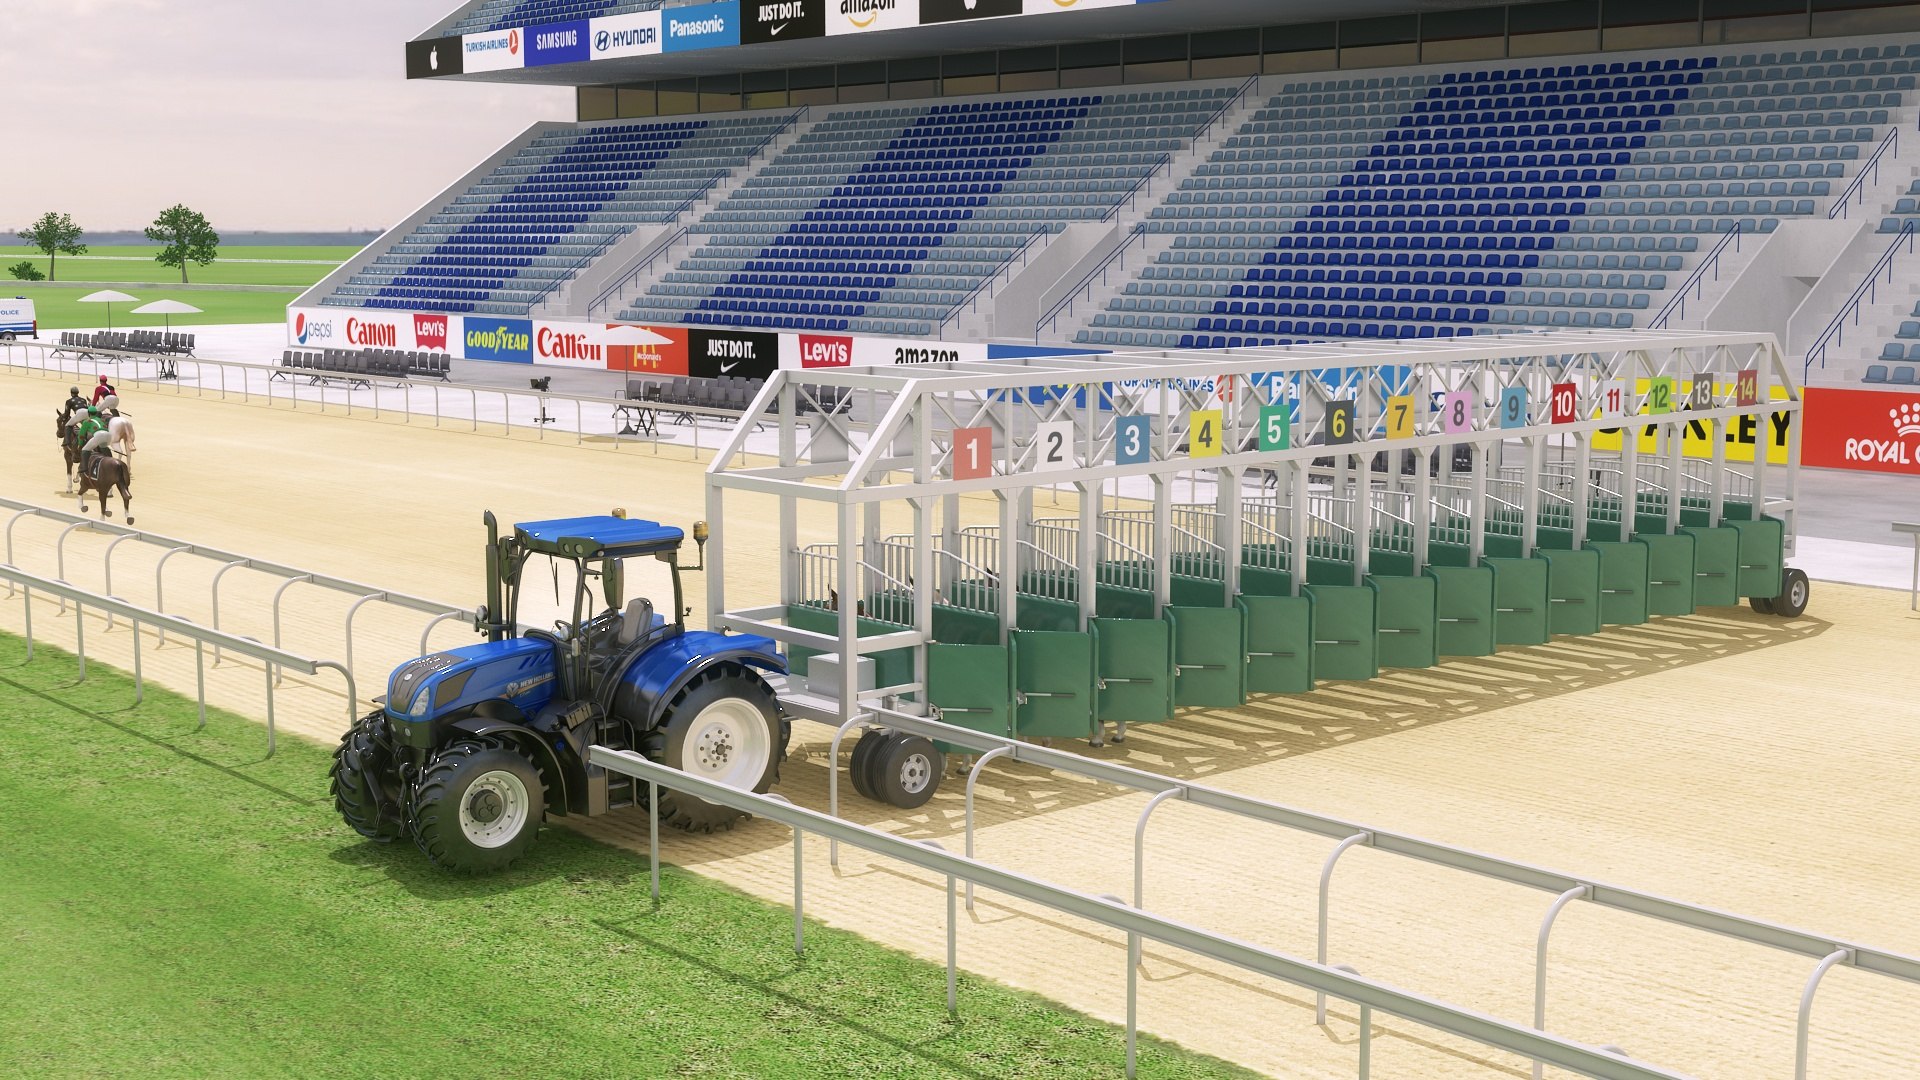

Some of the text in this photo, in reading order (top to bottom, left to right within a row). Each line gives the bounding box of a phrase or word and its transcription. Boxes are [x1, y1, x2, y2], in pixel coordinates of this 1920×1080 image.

[758, 1, 804, 22] JUST DO IT.
[613, 27, 656, 47] HYUNDAI
[670, 14, 724, 38] Panasonic
[466, 38, 508, 53] TURKISH AIRLINES
[536, 30, 577, 50] SAMSUNG
[308, 319, 332, 341] pepsi
[346, 317, 396, 347] Canon
[537, 326, 601, 360] Canon
[707, 339, 756, 359] JUST DO IT.
[1606, 388, 1620, 412] 11
[1652, 383, 1668, 408] 12
[1695, 379, 1711, 405] 13
[1739, 377, 1754, 400] 14
[1453, 399, 1465, 427] 8
[1508, 395, 1519, 422] 9
[1555, 390, 1573, 417] 10
[1267, 415, 1282, 444] 5
[1332, 409, 1346, 438] 6
[1394, 404, 1408, 431] 7
[1047, 431, 1063, 463] 2
[1124, 424, 1140, 456] 3
[1198, 420, 1213, 448] 4
[966, 437, 978, 470] 1
[1845, 437, 1911, 465] ROYAL
